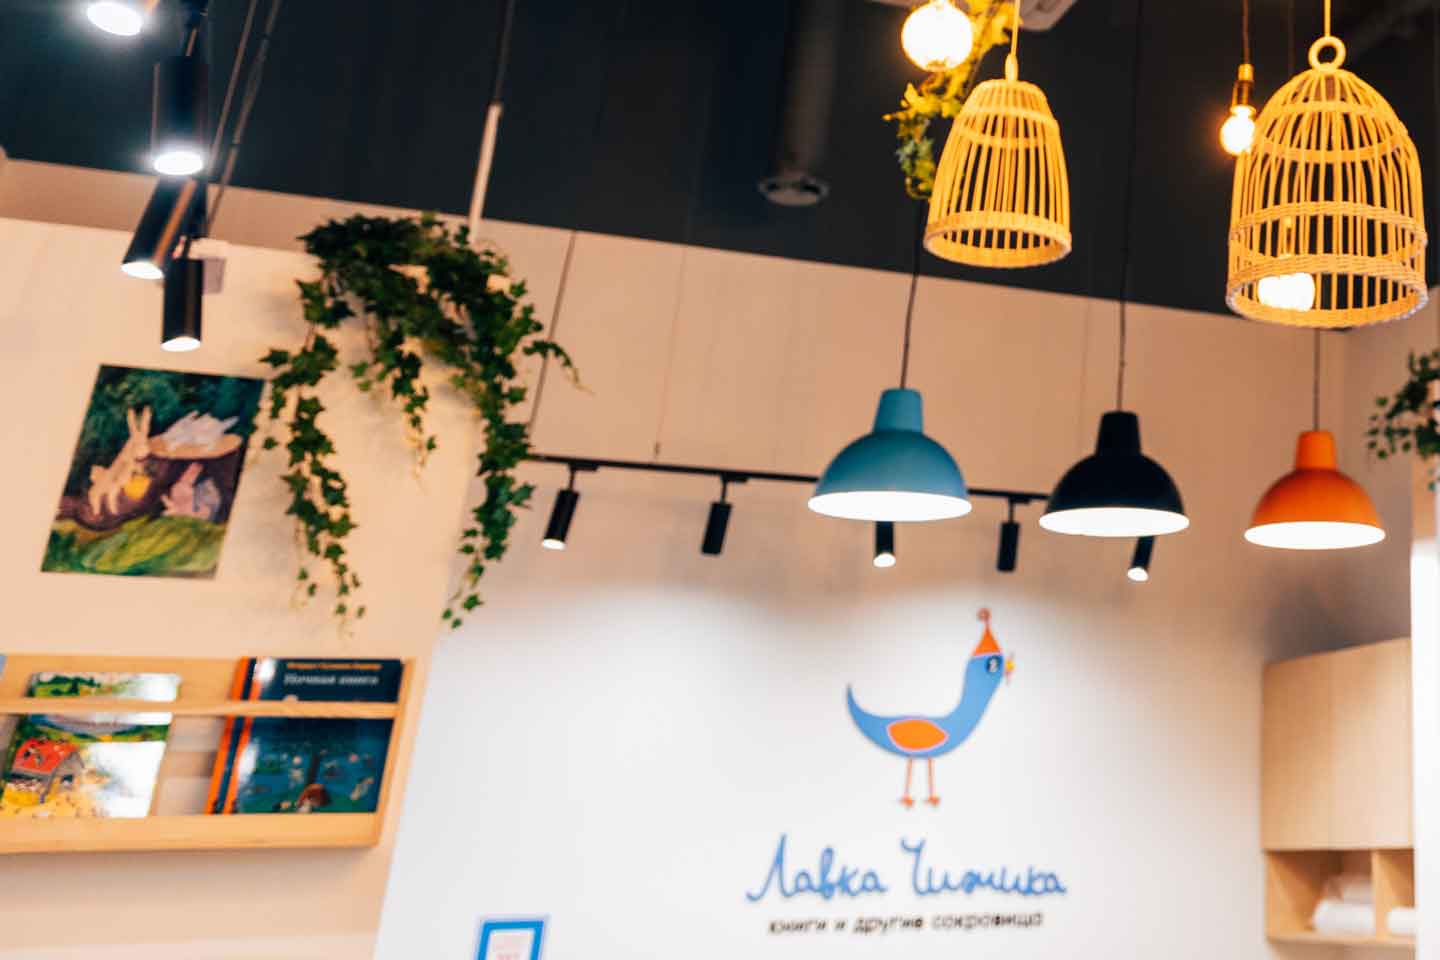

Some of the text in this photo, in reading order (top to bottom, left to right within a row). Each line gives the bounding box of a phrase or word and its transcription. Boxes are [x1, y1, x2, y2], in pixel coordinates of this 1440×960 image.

[745, 834, 1068, 902] Лавка Чижика
[768, 912, 1043, 936] книги и другие сокровища
